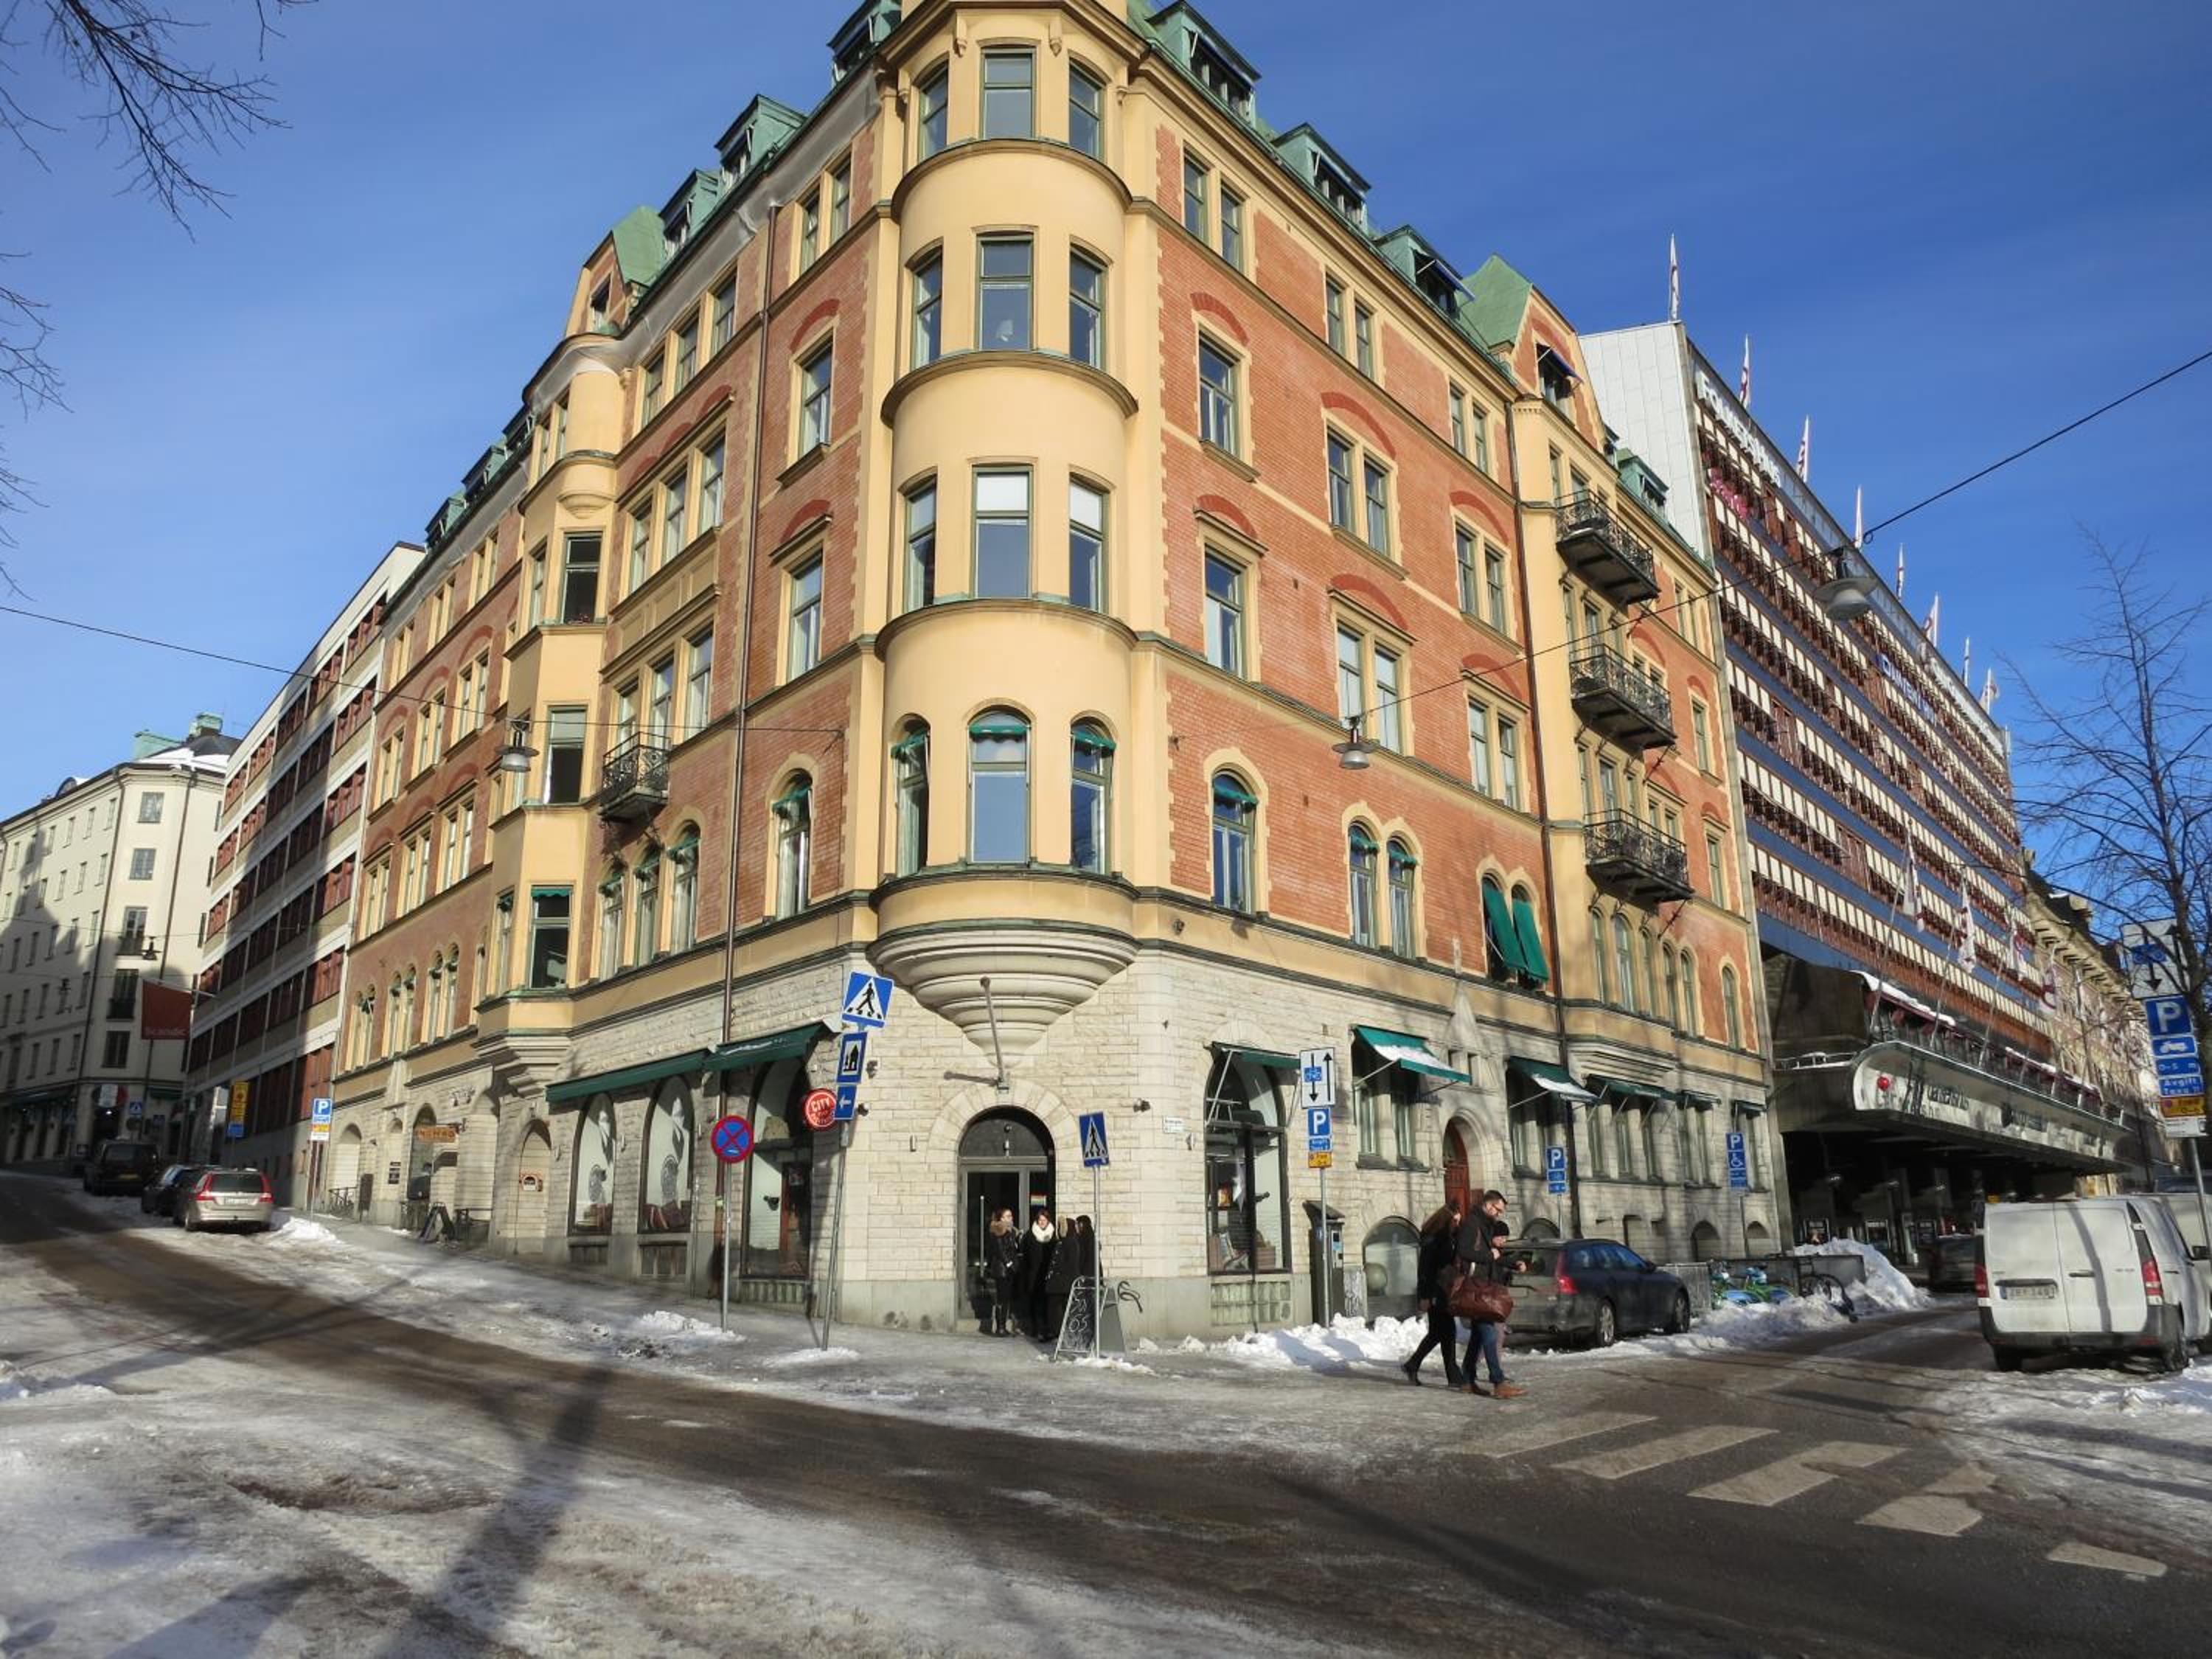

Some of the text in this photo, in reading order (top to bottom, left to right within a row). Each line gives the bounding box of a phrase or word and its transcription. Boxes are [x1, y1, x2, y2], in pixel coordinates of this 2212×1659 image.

[2156, 1001, 2180, 1032] P
[319, 1101, 329, 1113] P
[810, 1096, 830, 1112] CITY
[1313, 1111, 1326, 1134] P
[1730, 1135, 1740, 1148] P
[1550, 1149, 1562, 1168] P
